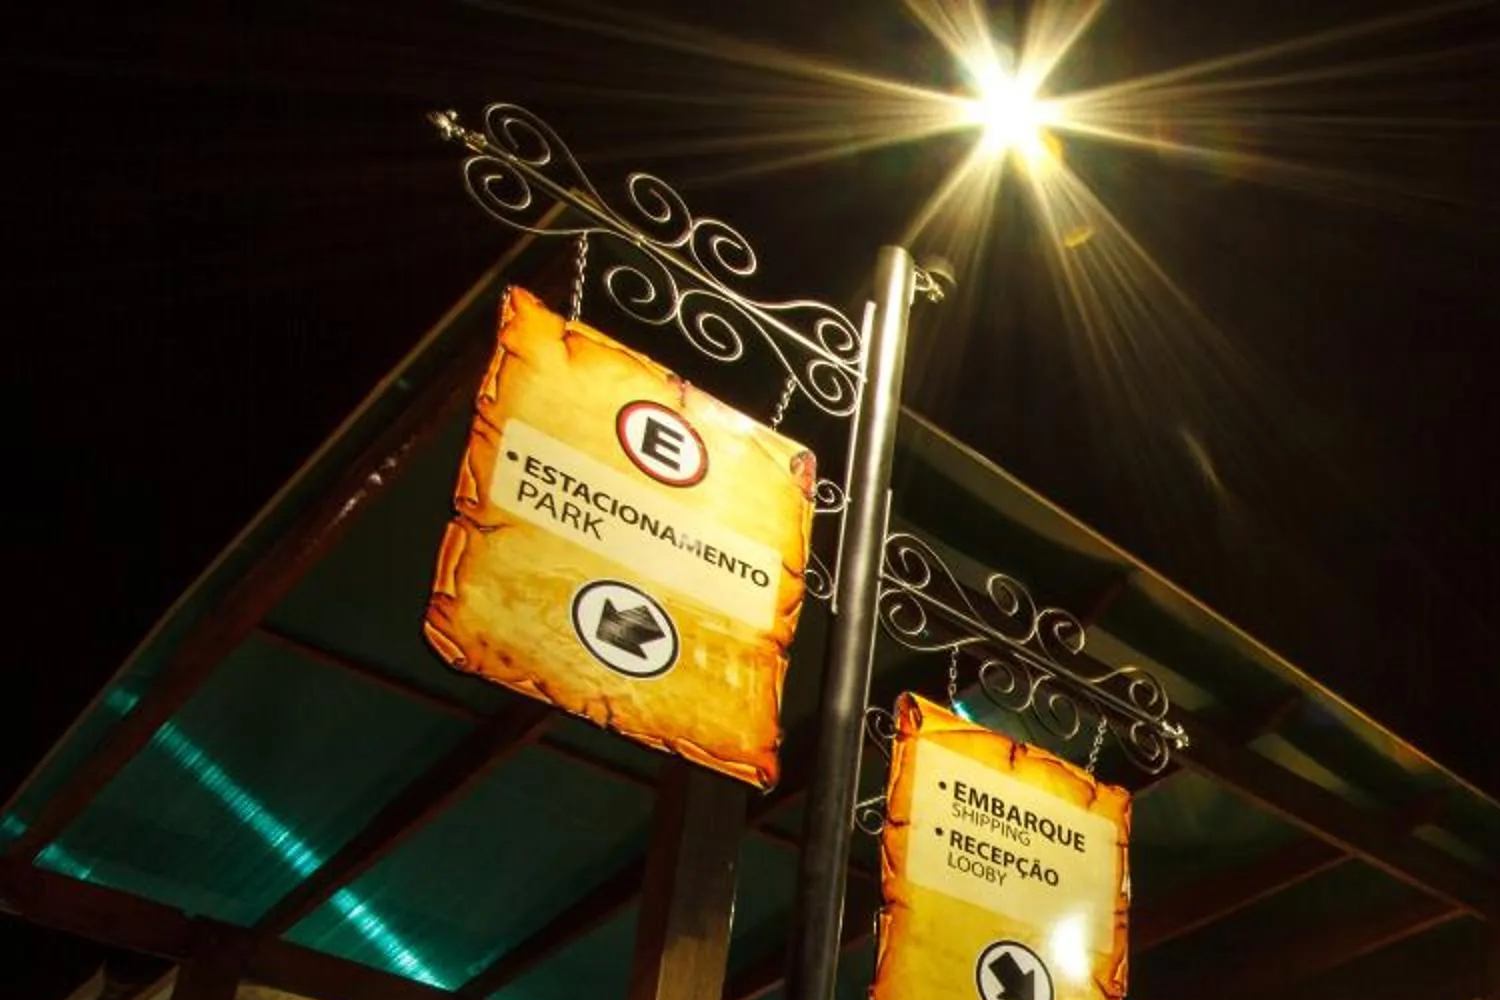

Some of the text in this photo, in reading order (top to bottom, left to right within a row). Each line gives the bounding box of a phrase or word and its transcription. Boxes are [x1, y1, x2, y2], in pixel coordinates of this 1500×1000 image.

[640, 416, 685, 472] E
[517, 480, 605, 541] PARK
[524, 455, 771, 589] ESTACIONAMENTO
[951, 802, 1031, 847] SHIPPING
[953, 781, 1086, 853] EMBARQUE
[947, 851, 1007, 887] LOOBY
[949, 829, 1059, 887] RECEPÇÃO
